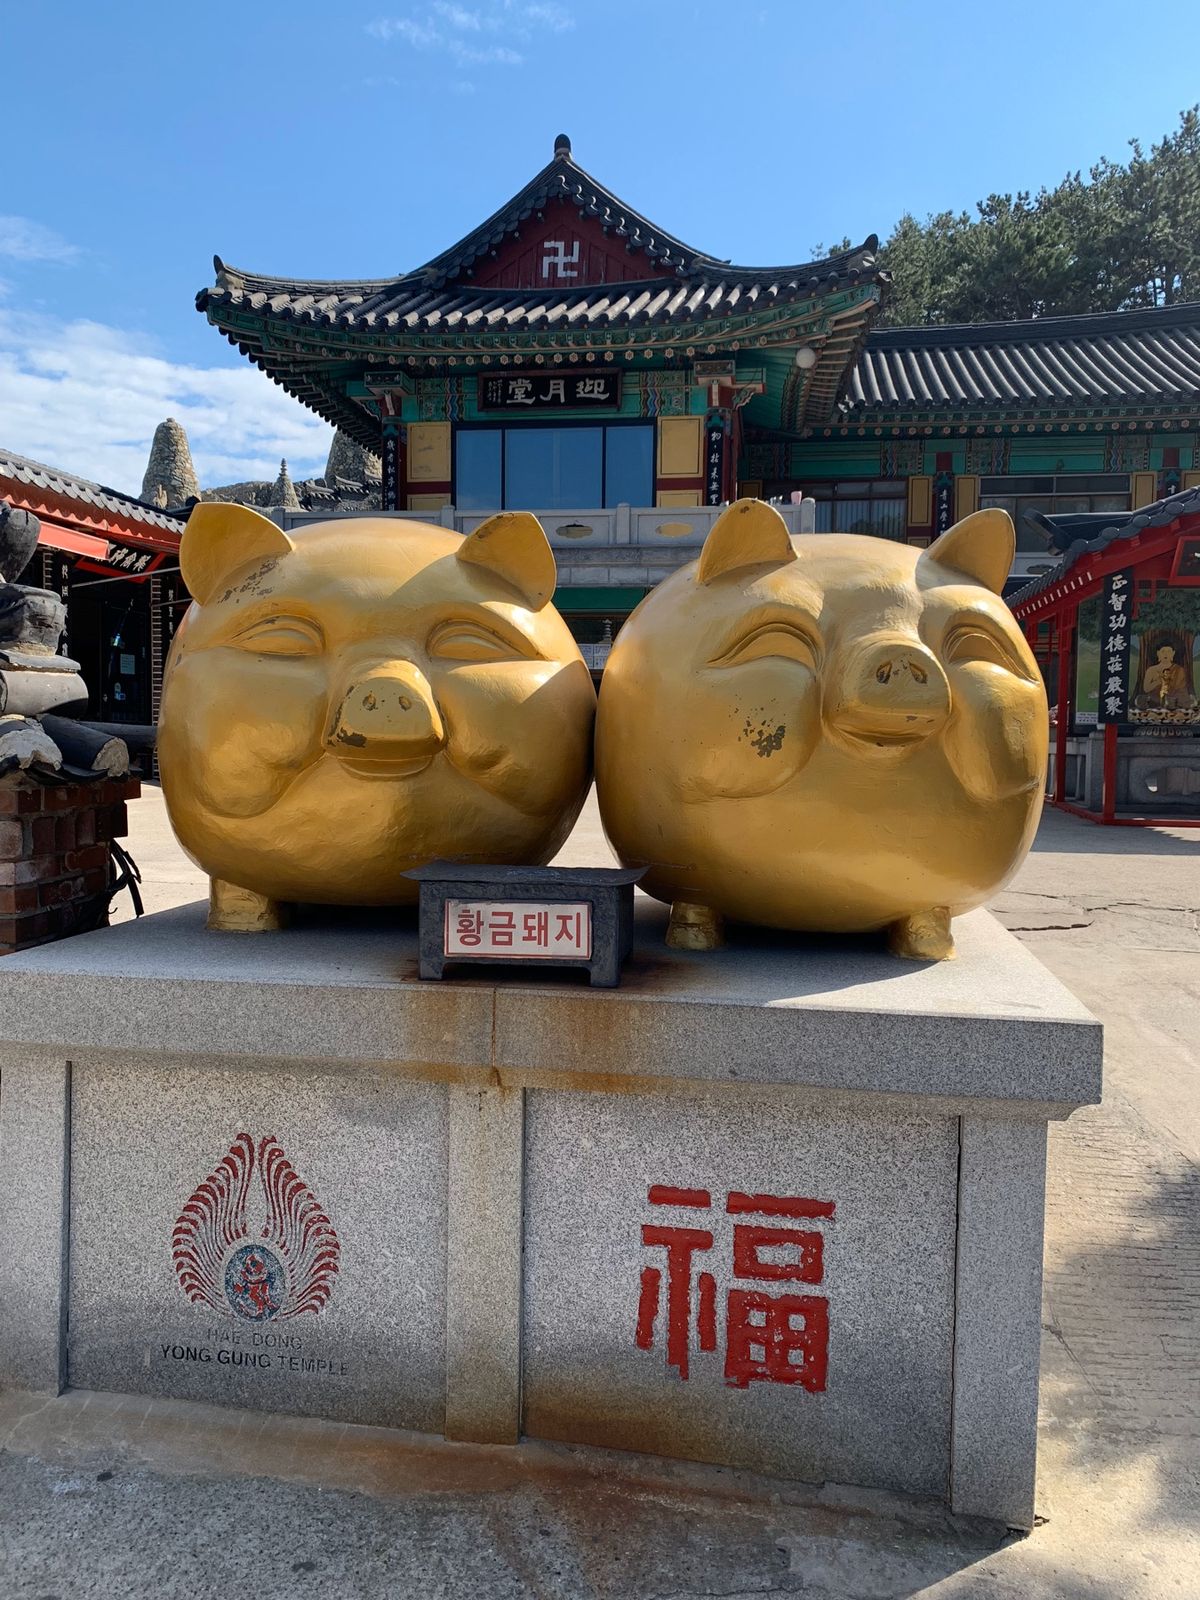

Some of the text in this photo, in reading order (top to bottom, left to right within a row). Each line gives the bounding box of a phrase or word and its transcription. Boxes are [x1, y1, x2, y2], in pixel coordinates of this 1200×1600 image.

[456, 909, 581, 948] 황금돼지
[635, 1185, 836, 1394] 福
[207, 1328, 302, 1350] HAE DONG
[160, 1343, 350, 1376] YONG GUNG TEMPLE
